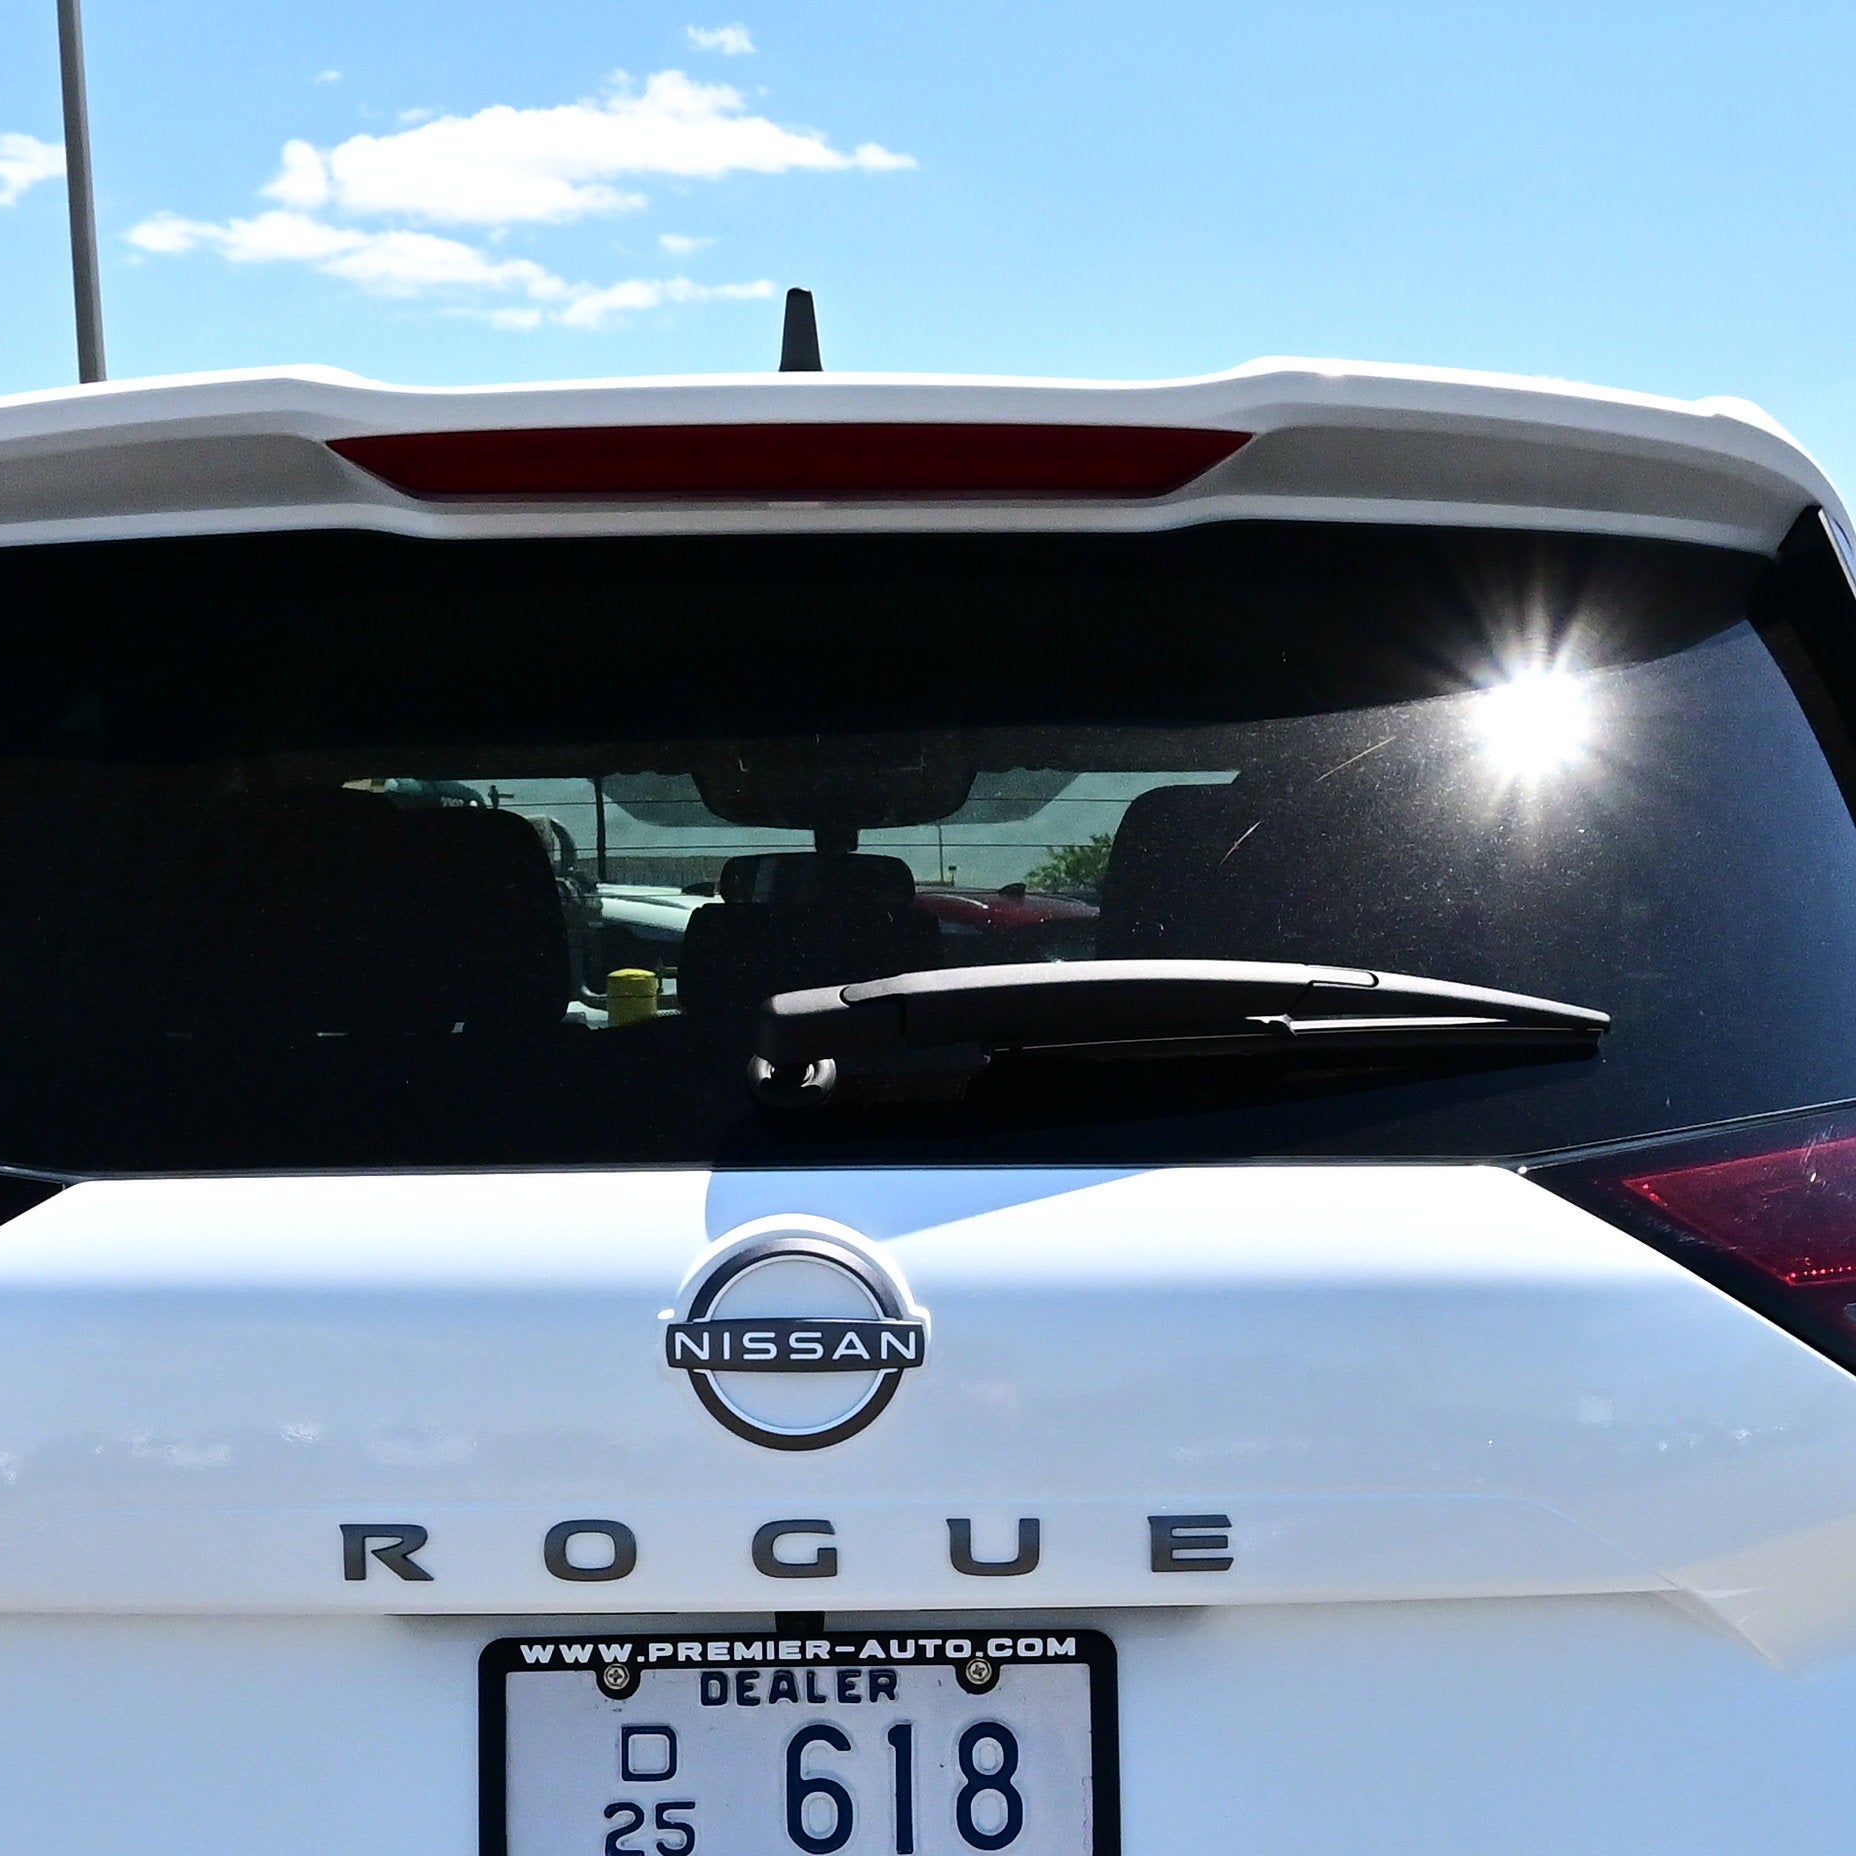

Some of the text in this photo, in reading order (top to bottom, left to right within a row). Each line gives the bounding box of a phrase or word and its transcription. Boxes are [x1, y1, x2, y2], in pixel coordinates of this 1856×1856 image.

[674, 1329, 918, 1363] NISSAN
[338, 1514, 1235, 1583] ROGUE
[520, 1637, 1077, 1664] WWW.PREMIER-AUTO.COM
[700, 1668, 898, 1707] DEALER
[786, 1721, 1023, 1855] 618
